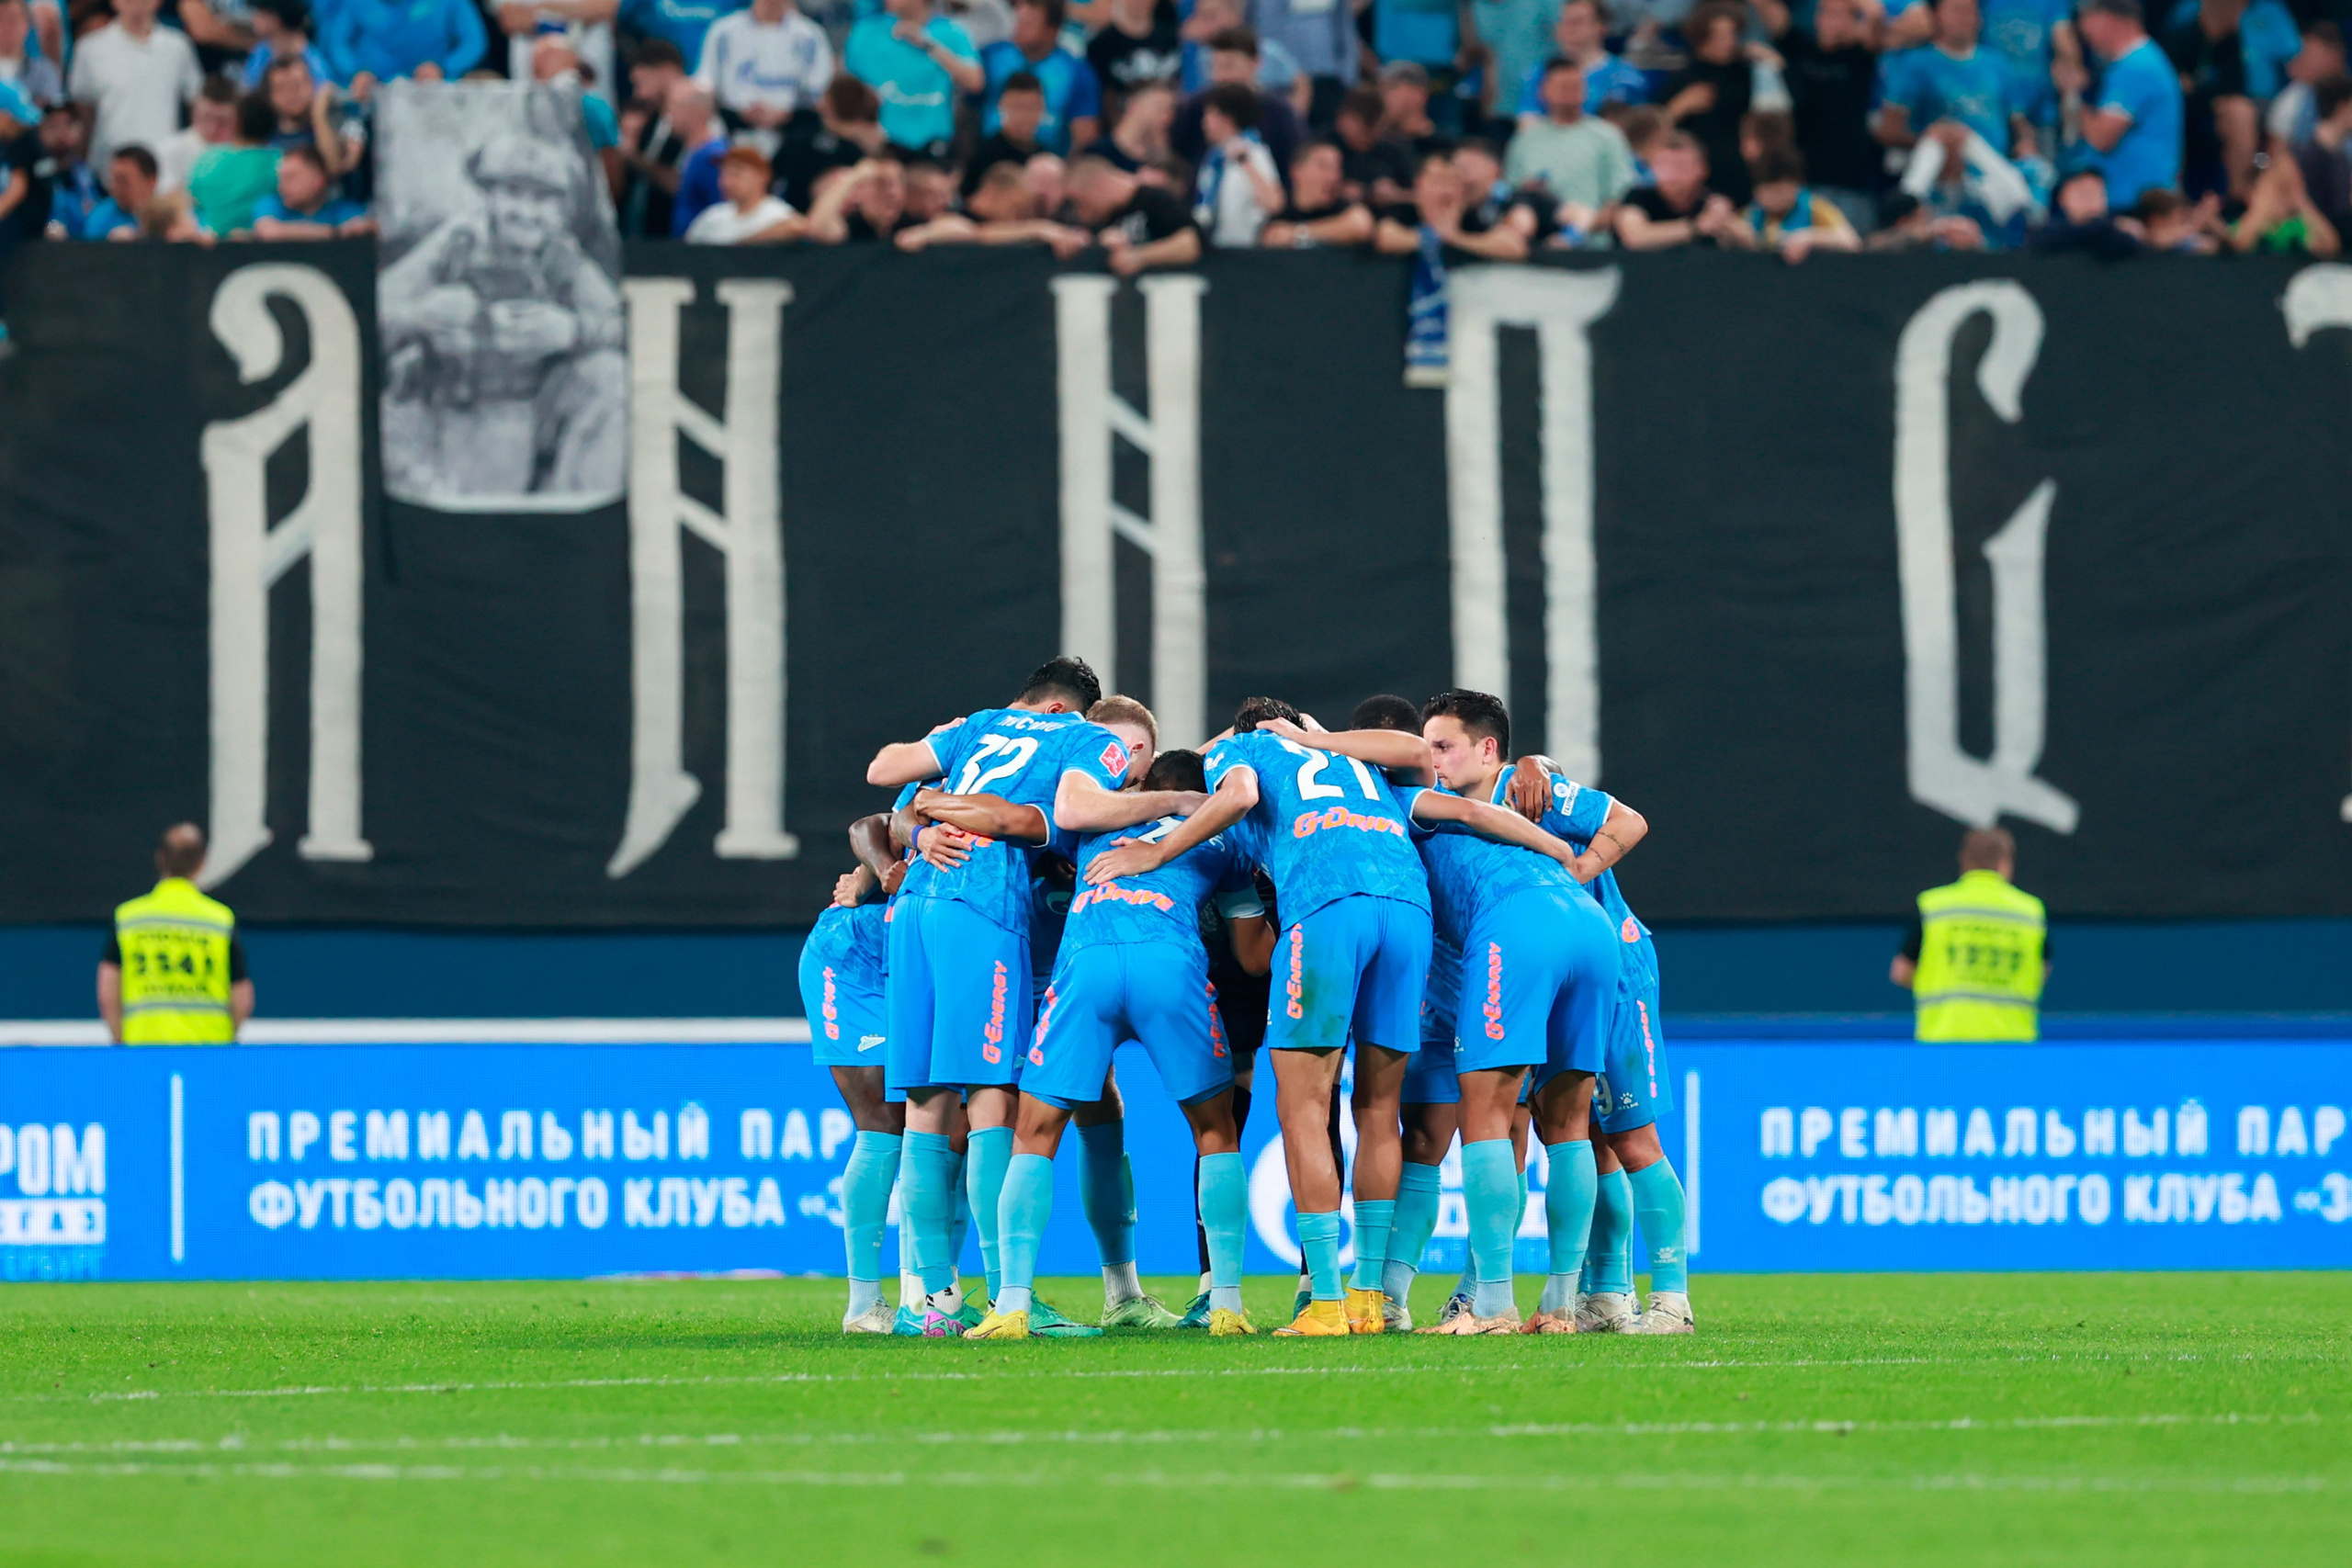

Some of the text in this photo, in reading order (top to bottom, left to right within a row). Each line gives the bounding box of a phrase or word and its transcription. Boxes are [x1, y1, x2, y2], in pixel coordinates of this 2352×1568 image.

[1281, 739, 1381, 801] 21
[982, 959, 1009, 1065] G-ENERGY
[248, 1102, 854, 1161] ПРЕМИАЛЬНЫЙ ПАР
[1760, 1099, 2347, 1158] ПРЕМИАЛЬНЫЙ ПАР
[249, 1177, 609, 1230] ФУТБОЛЬНОГО
[625, 1177, 786, 1228] КЛУБА
[1761, 1174, 2111, 1225] ФУТБОЛЬНОГО
[2123, 1172, 2282, 1224] КЛУБА
